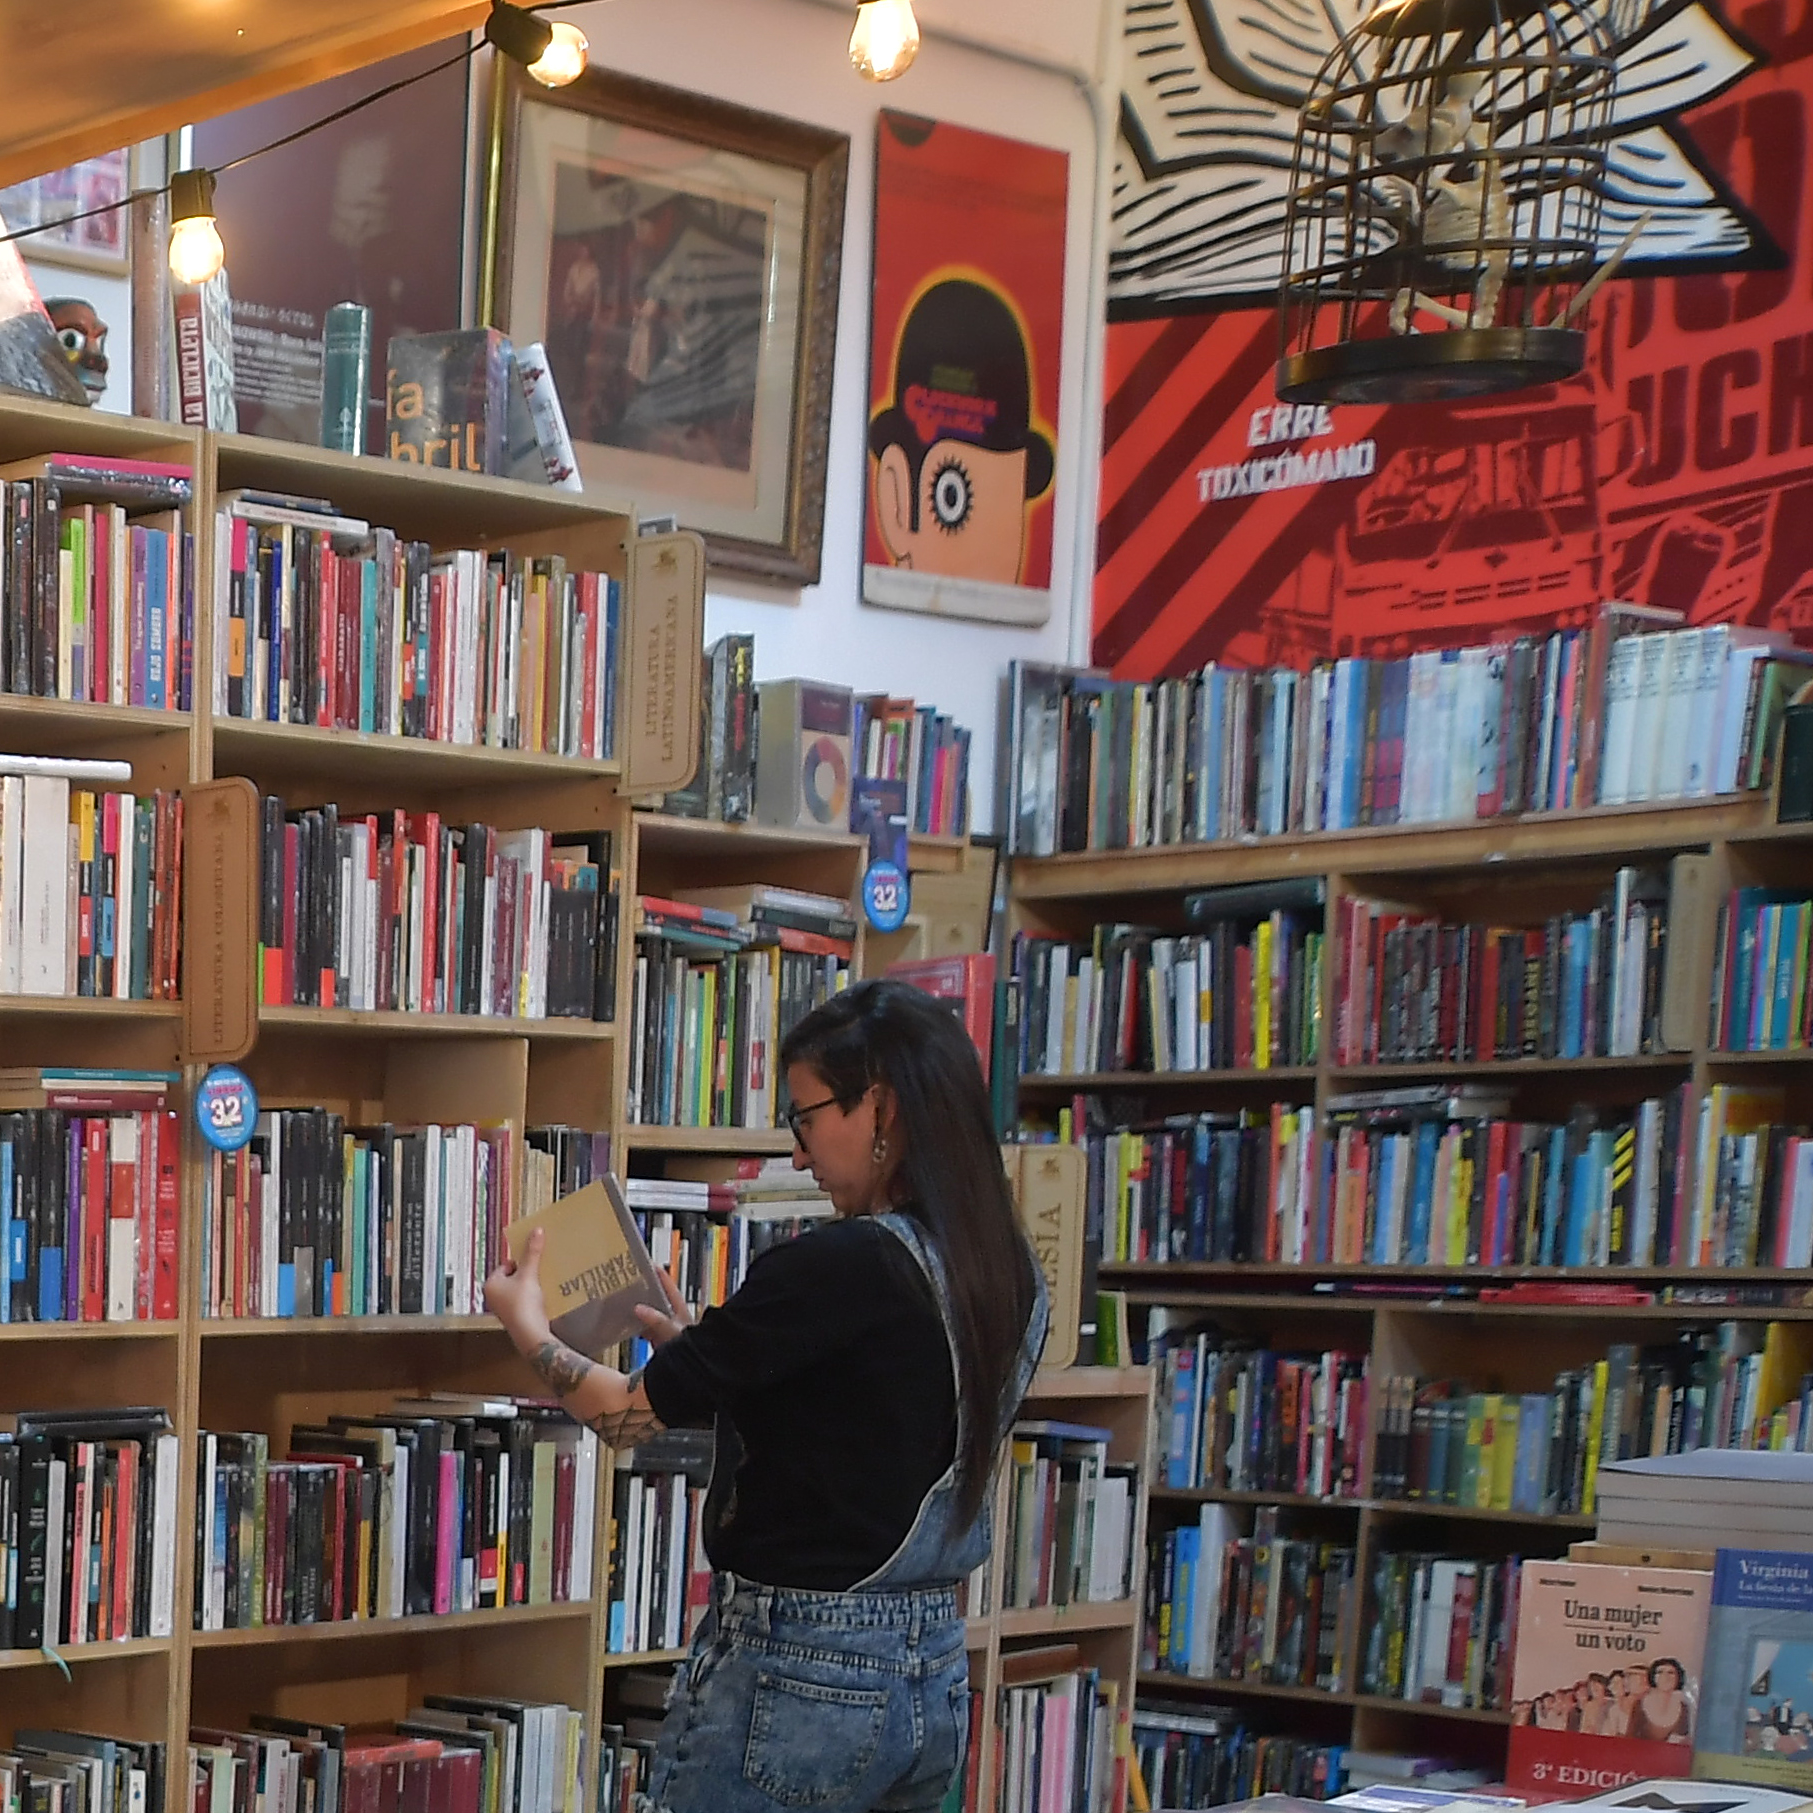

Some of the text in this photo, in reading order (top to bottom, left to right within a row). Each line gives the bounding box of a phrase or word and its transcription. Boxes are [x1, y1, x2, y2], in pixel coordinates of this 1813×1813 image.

[179, 316, 202, 398] BICICLETA
[1739, 1559, 1809, 1581] Virginia
[1564, 1600, 1663, 1629] Una mujer
[1575, 1631, 1647, 1653] un voto
